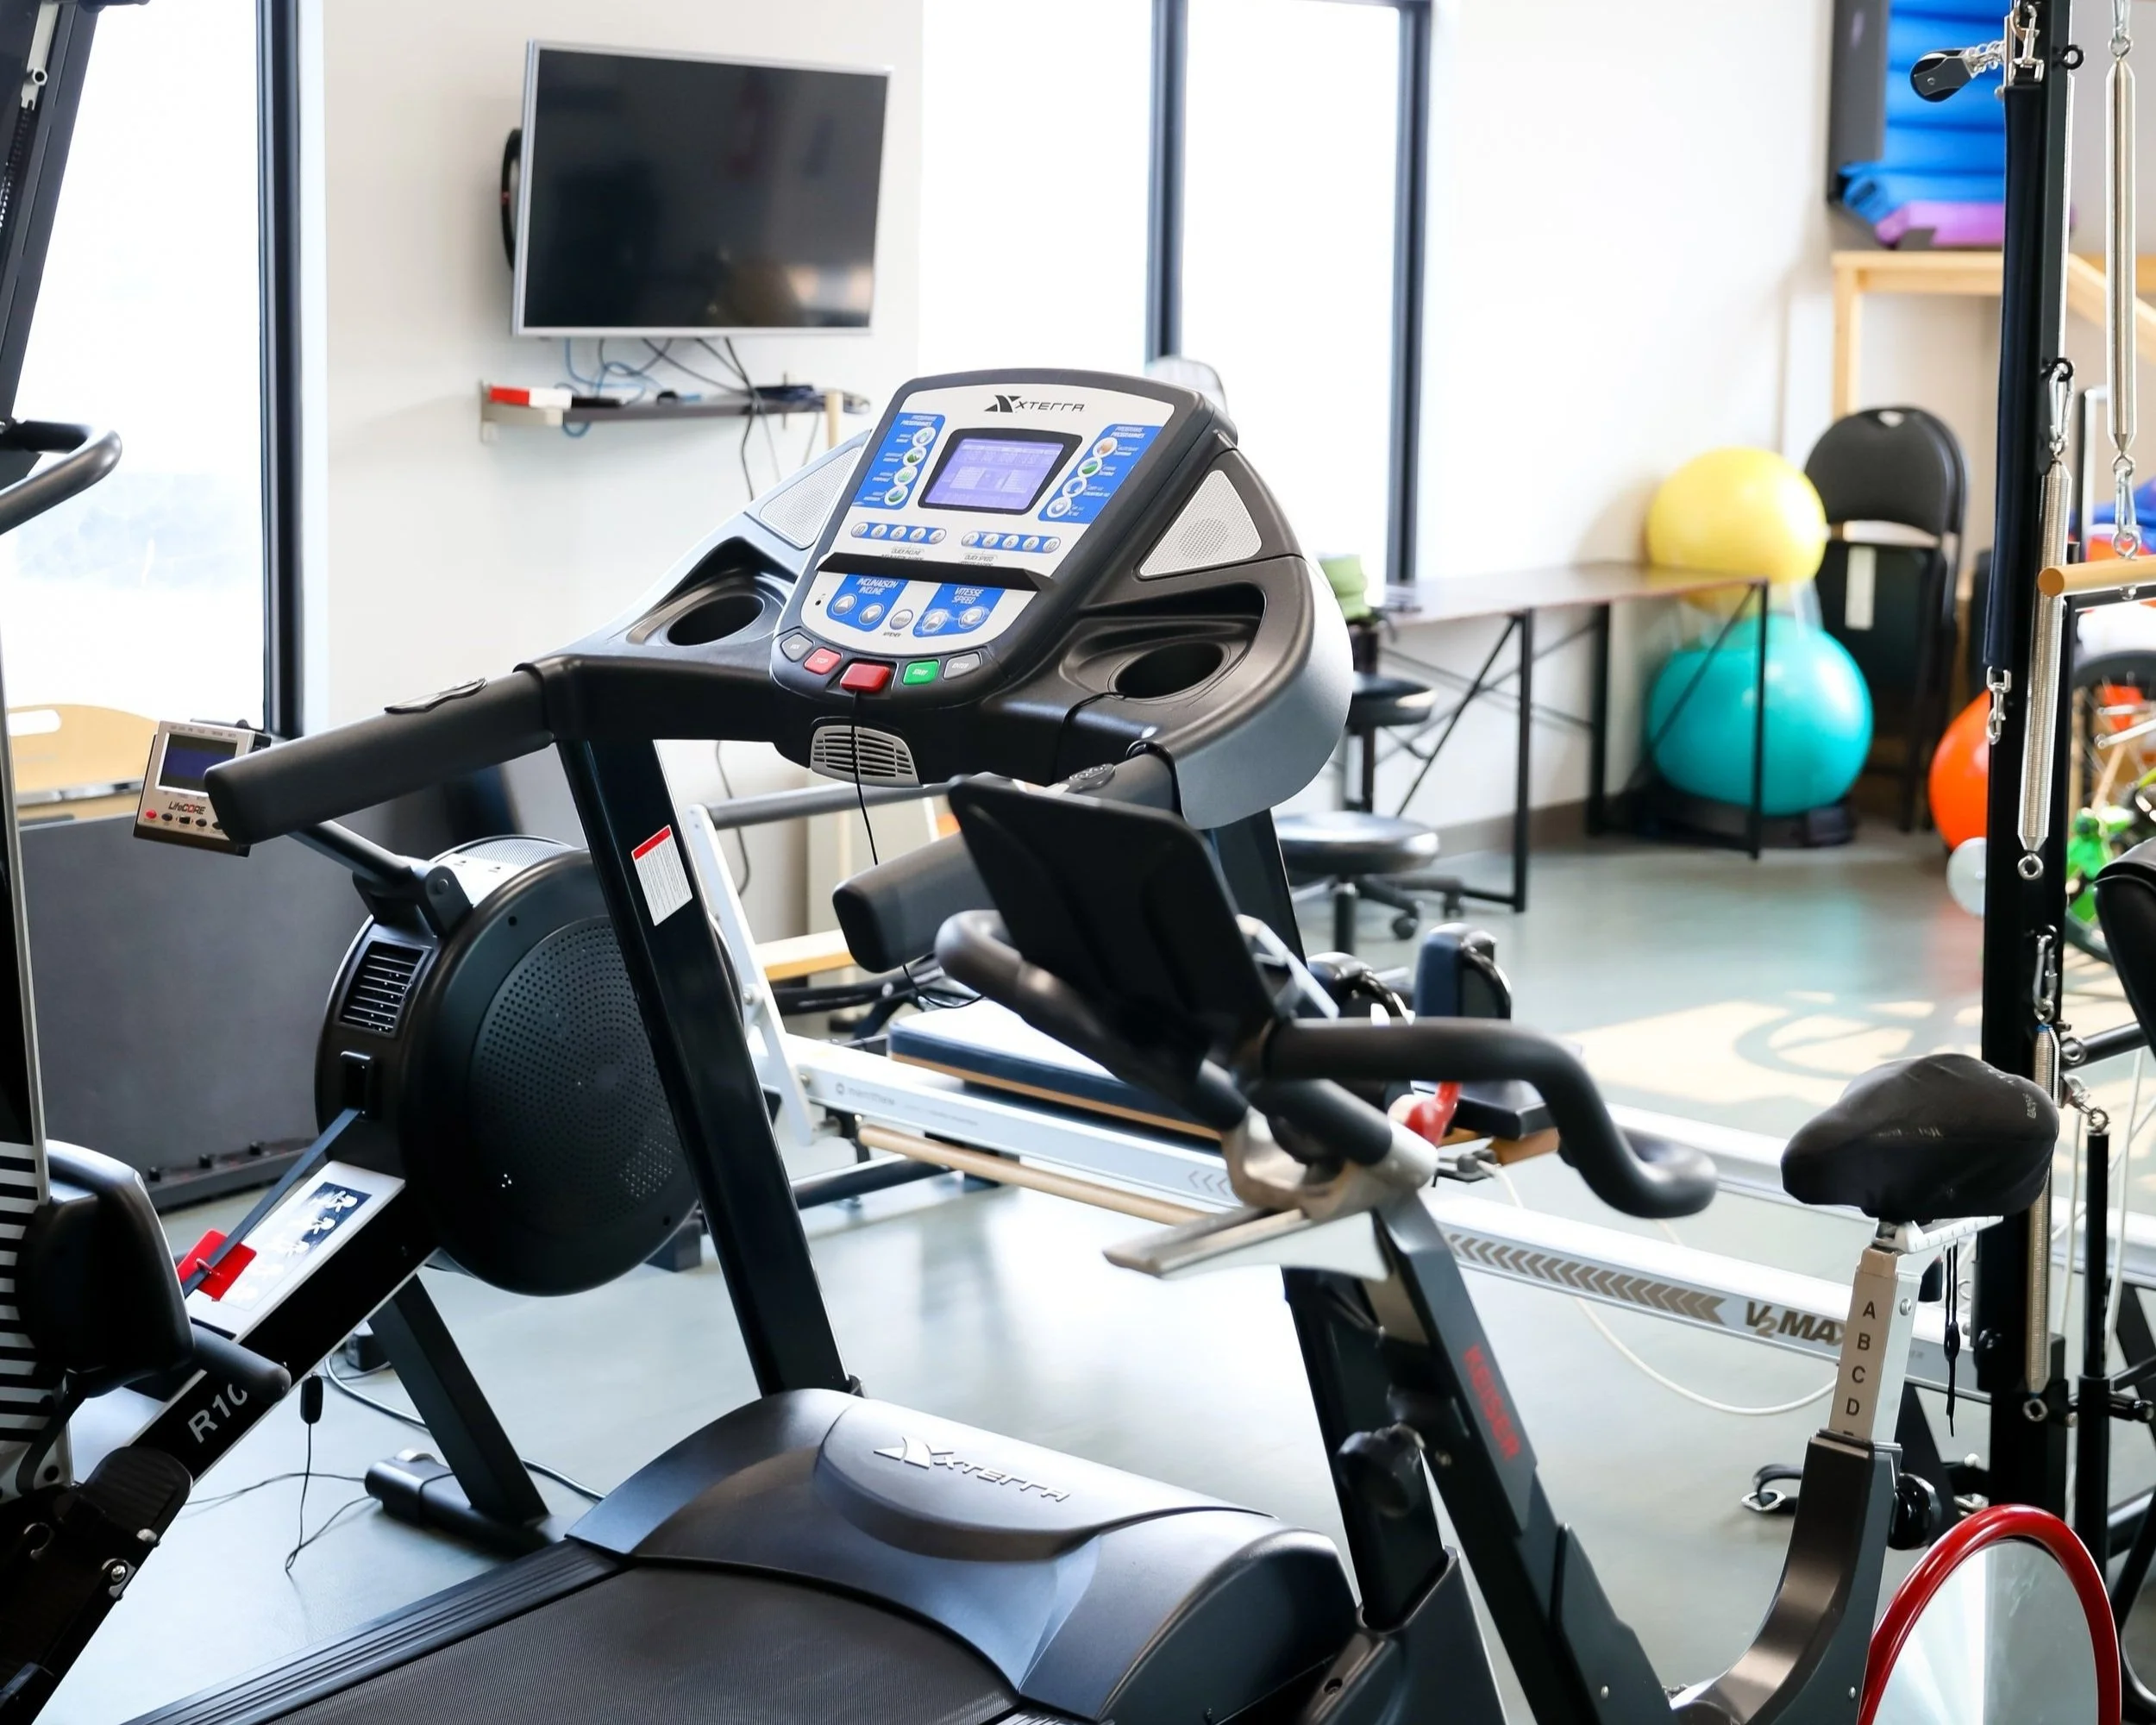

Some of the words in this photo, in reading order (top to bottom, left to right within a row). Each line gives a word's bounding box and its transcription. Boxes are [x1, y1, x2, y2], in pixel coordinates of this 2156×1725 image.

[856, 578, 899, 588] INCLINAISON
[858, 586, 886, 595] INCLINE
[955, 587, 984, 597] VITESSE
[168, 800, 206, 815] LifeCORE
[1862, 1301, 1876, 1320] A
[1857, 1333, 1871, 1351] B
[1852, 1365, 1866, 1383] C
[1846, 1398, 1859, 1416] D
